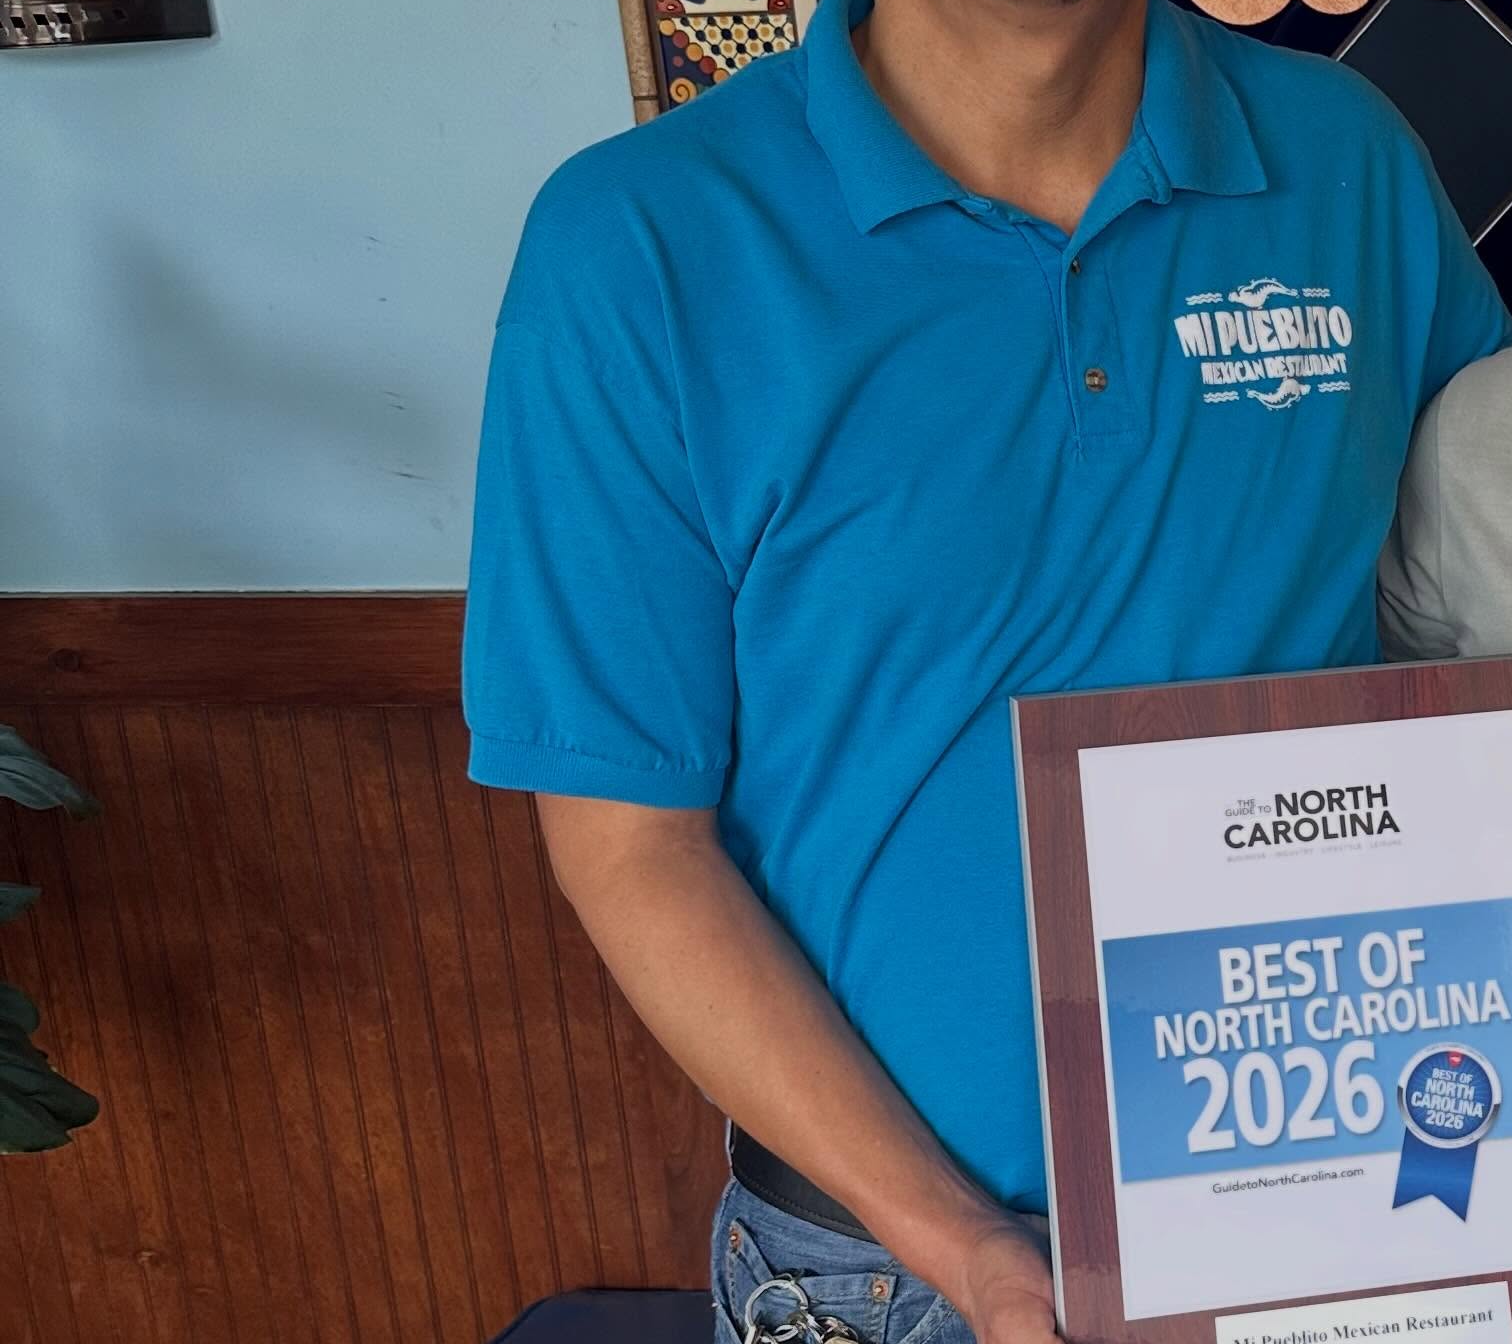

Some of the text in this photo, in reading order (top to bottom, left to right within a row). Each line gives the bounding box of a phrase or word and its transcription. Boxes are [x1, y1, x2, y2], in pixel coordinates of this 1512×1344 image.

[1174, 305, 1353, 357] MI PUEBLITO
[1201, 353, 1347, 385] MEXICAN RESTAURANT
[1225, 804, 1272, 817] GUIDE TO
[1237, 798, 1256, 808] THE
[1275, 783, 1388, 817] NORTH
[1224, 810, 1401, 849] CAROLINA
[1219, 928, 1426, 1004] BEST OF
[1154, 979, 1511, 1059] NORTH CAROLINA
[1425, 1077, 1475, 1100] NORTH
[1432, 1067, 1473, 1084] BEST OF
[1182, 1040, 1385, 1154] 2026
[1411, 1091, 1485, 1119] CAROLINA
[1425, 1109, 1464, 1130] 2026
[1212, 1166, 1364, 1195] GuidetoNorthCarolina.com
[1333, 1320, 1400, 1340] Mexican
[1406, 1308, 1494, 1332] Restaurant
